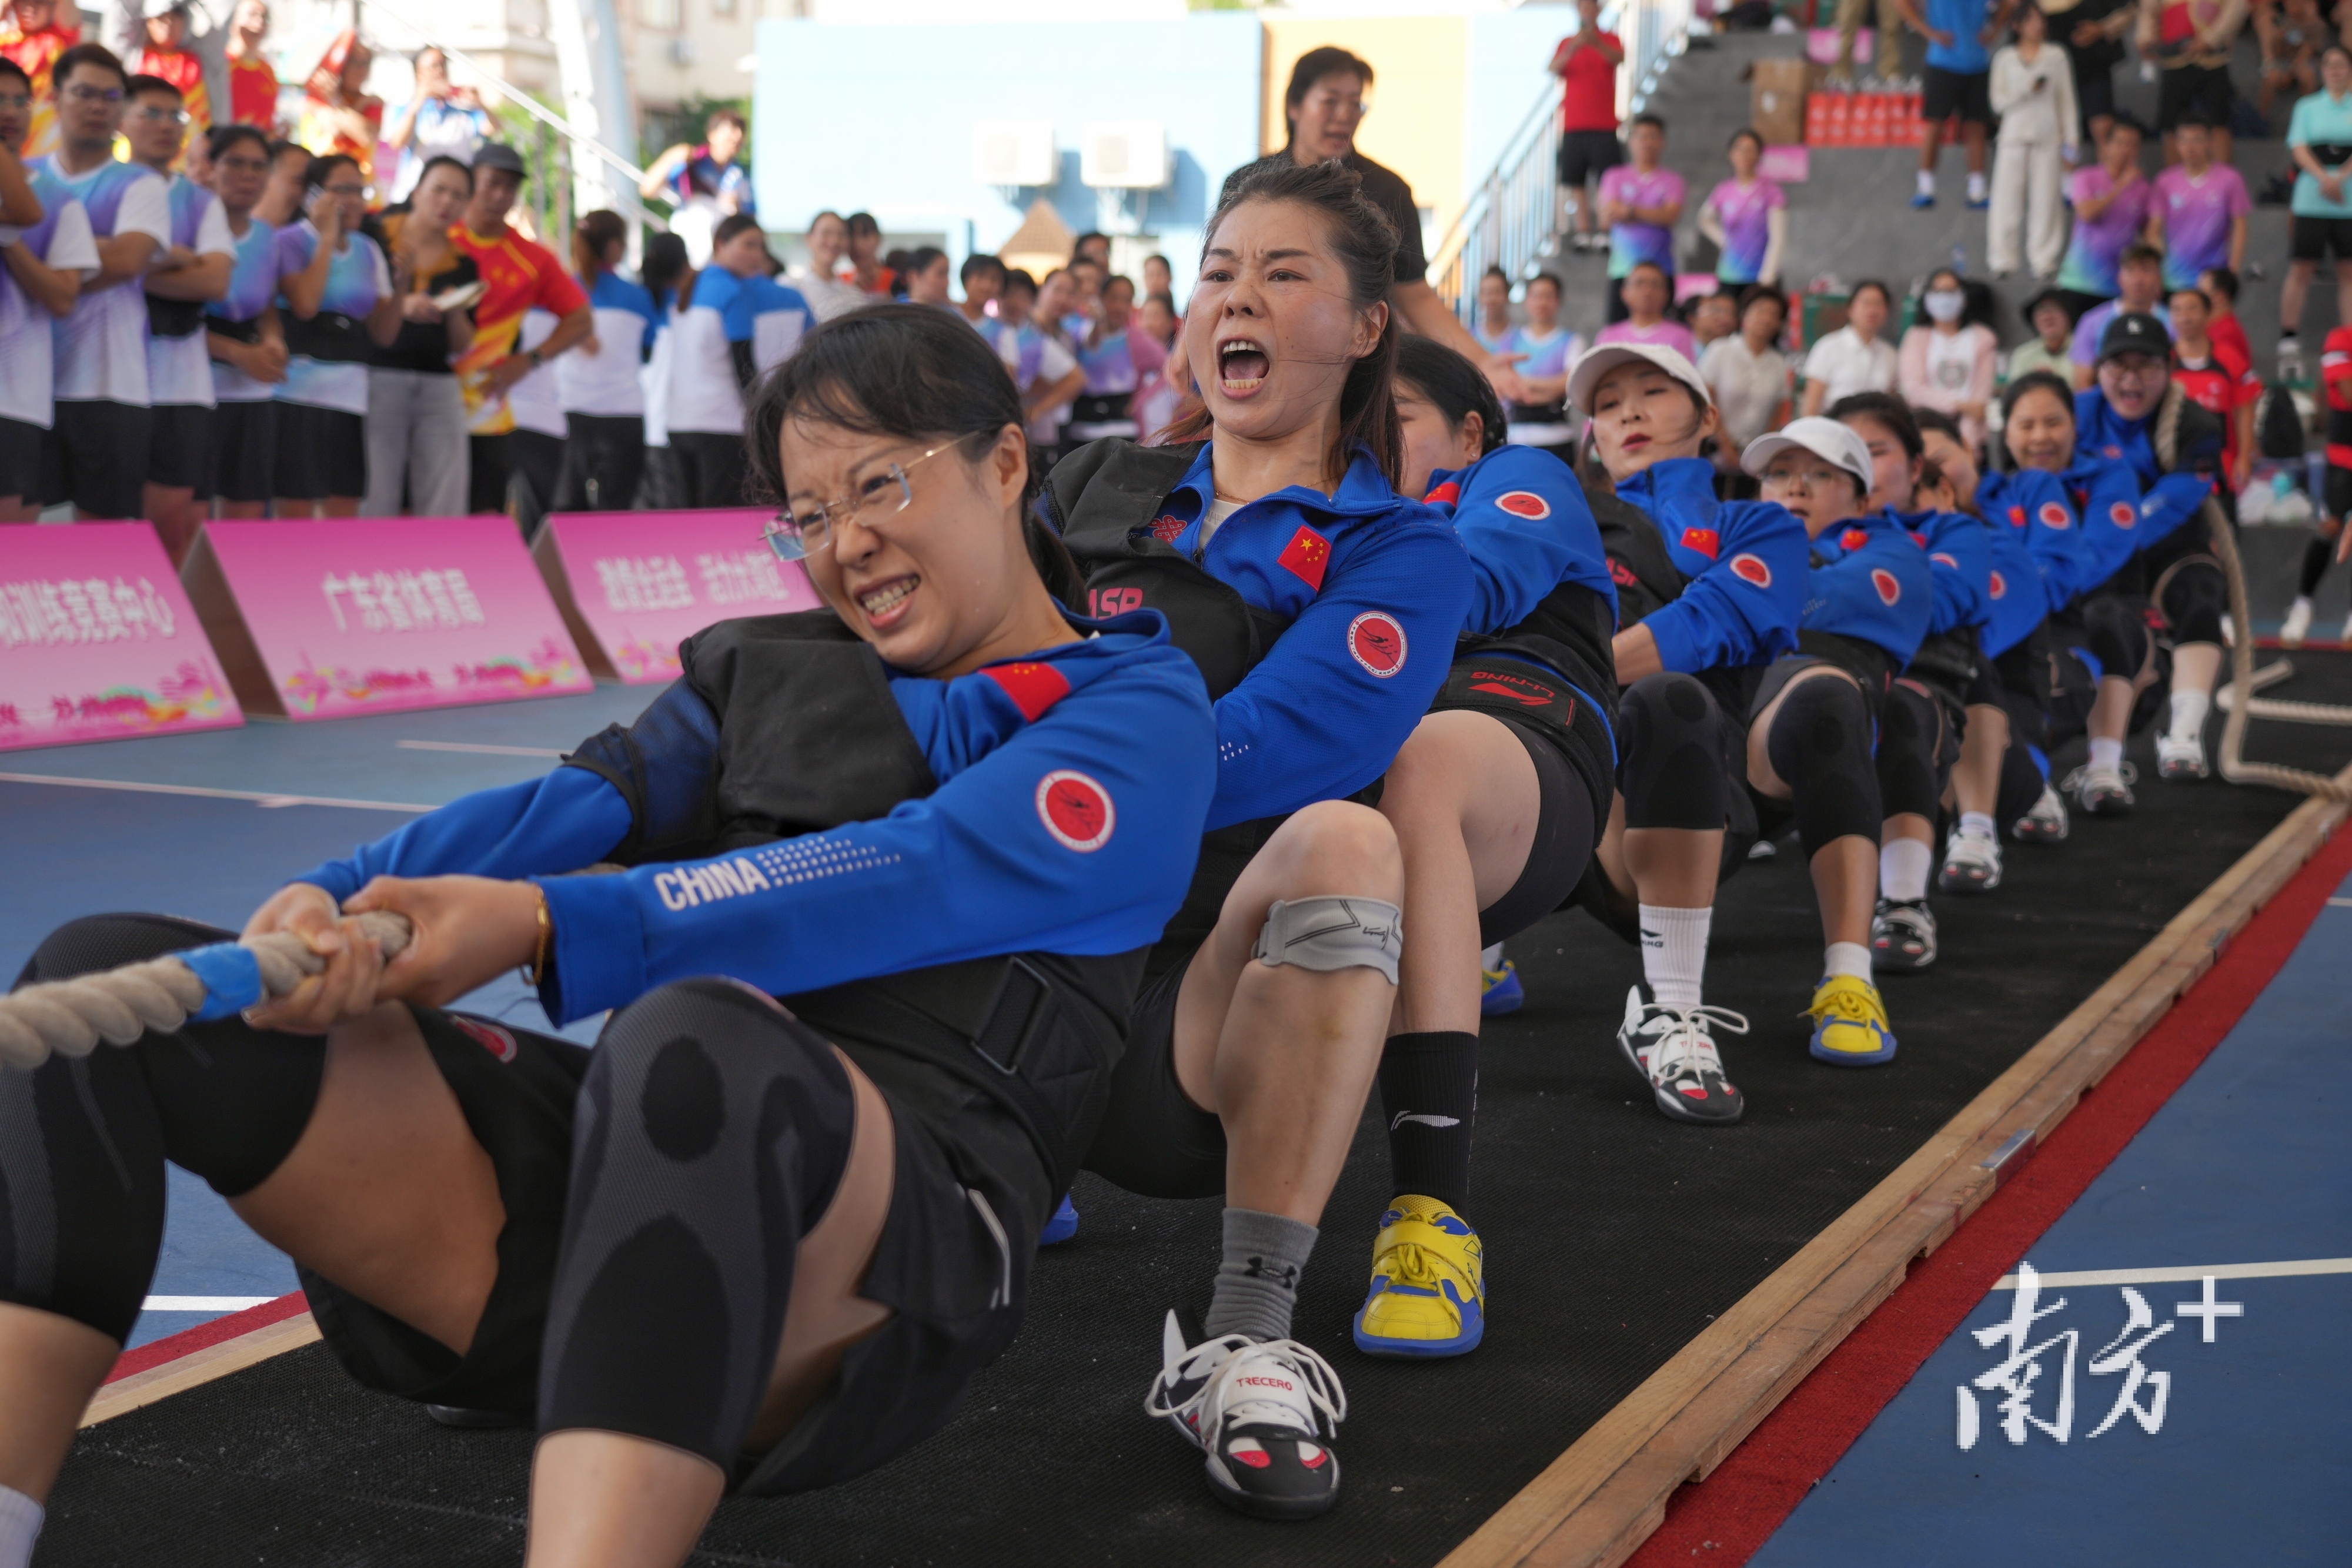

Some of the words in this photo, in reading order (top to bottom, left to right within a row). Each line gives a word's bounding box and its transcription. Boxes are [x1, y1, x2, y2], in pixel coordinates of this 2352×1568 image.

[320, 568, 487, 634] 广东省体育局
[1471, 671, 1555, 698] LI-NING
[654, 856, 771, 911] CHINA
[1236, 1376, 1293, 1391] TRECERO
